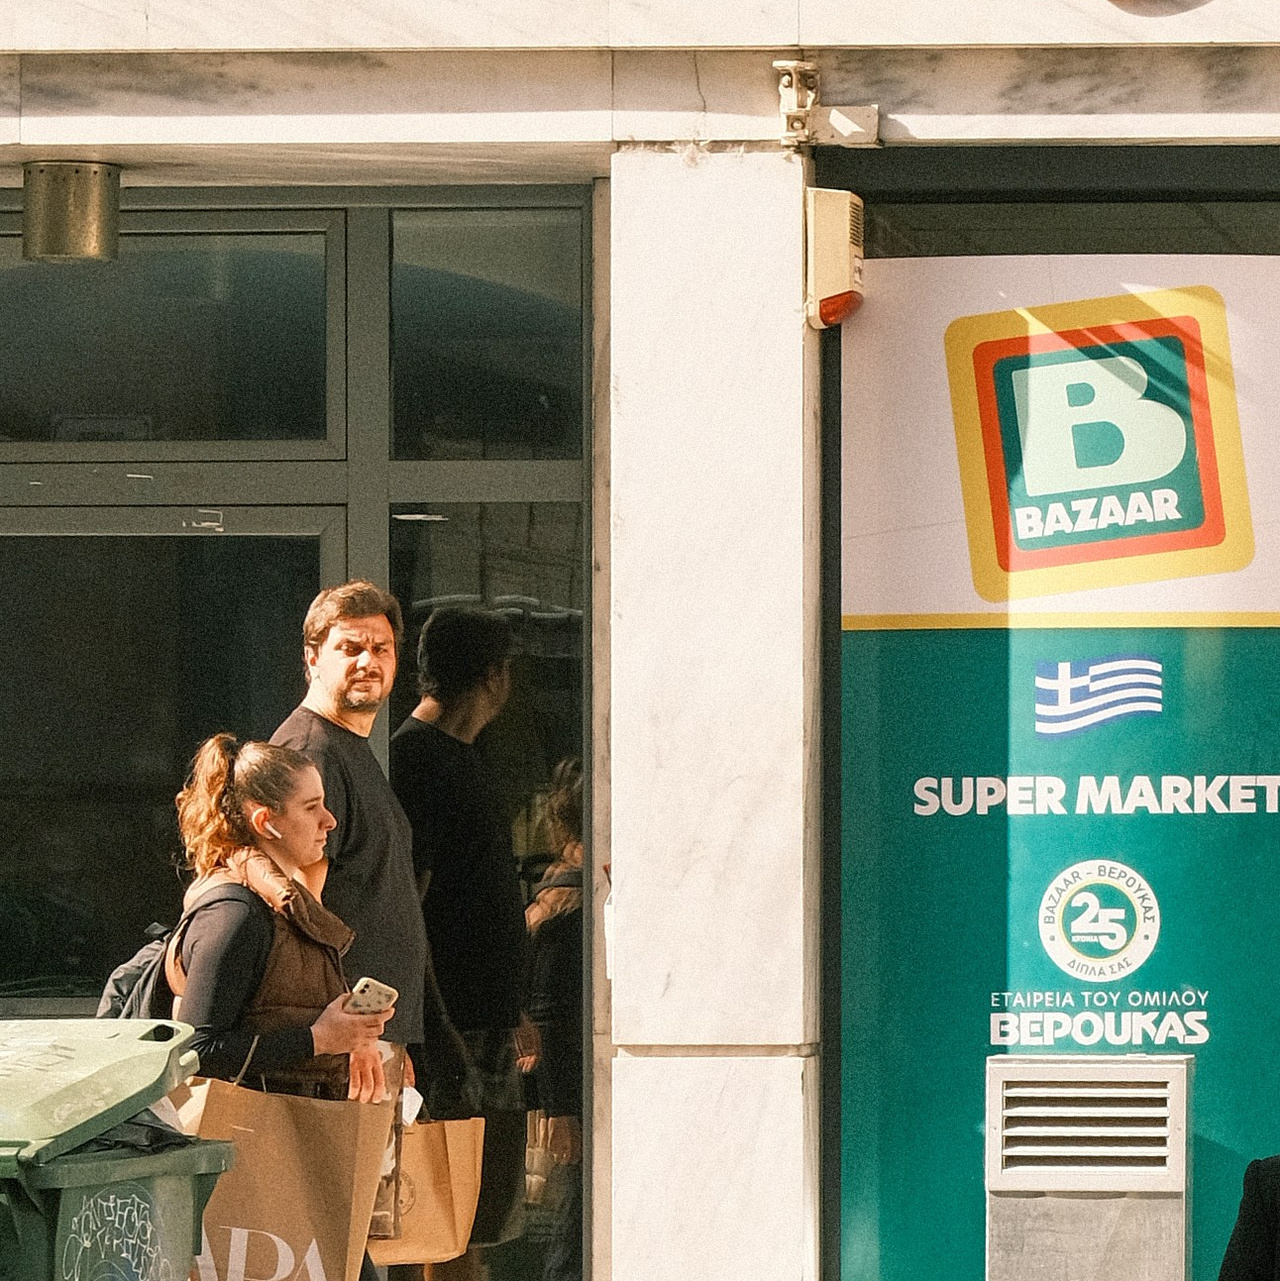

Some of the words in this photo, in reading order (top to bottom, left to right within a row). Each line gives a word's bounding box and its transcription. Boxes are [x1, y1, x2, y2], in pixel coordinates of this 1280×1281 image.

[1011, 356, 1187, 497] B
[1014, 488, 1183, 540] BAZAAR
[913, 776, 1066, 816] SUPER
[1043, 870, 1083, 924] BAZAAR
[1070, 891, 1127, 951] 25
[1097, 865, 1156, 924] ΒΕΡΟΥΚΑΣ
[1067, 959, 1107, 977] ΔΙΠΛΑ
[1109, 956, 1133, 975] ΣΑΣ
[990, 991, 1075, 1008] ΕΤΑΙΡΕΙΑ
[1080, 991, 1121, 1008] ΤΟΥ
[1127, 990, 1209, 1007] ΟΜΙΛΟΥ
